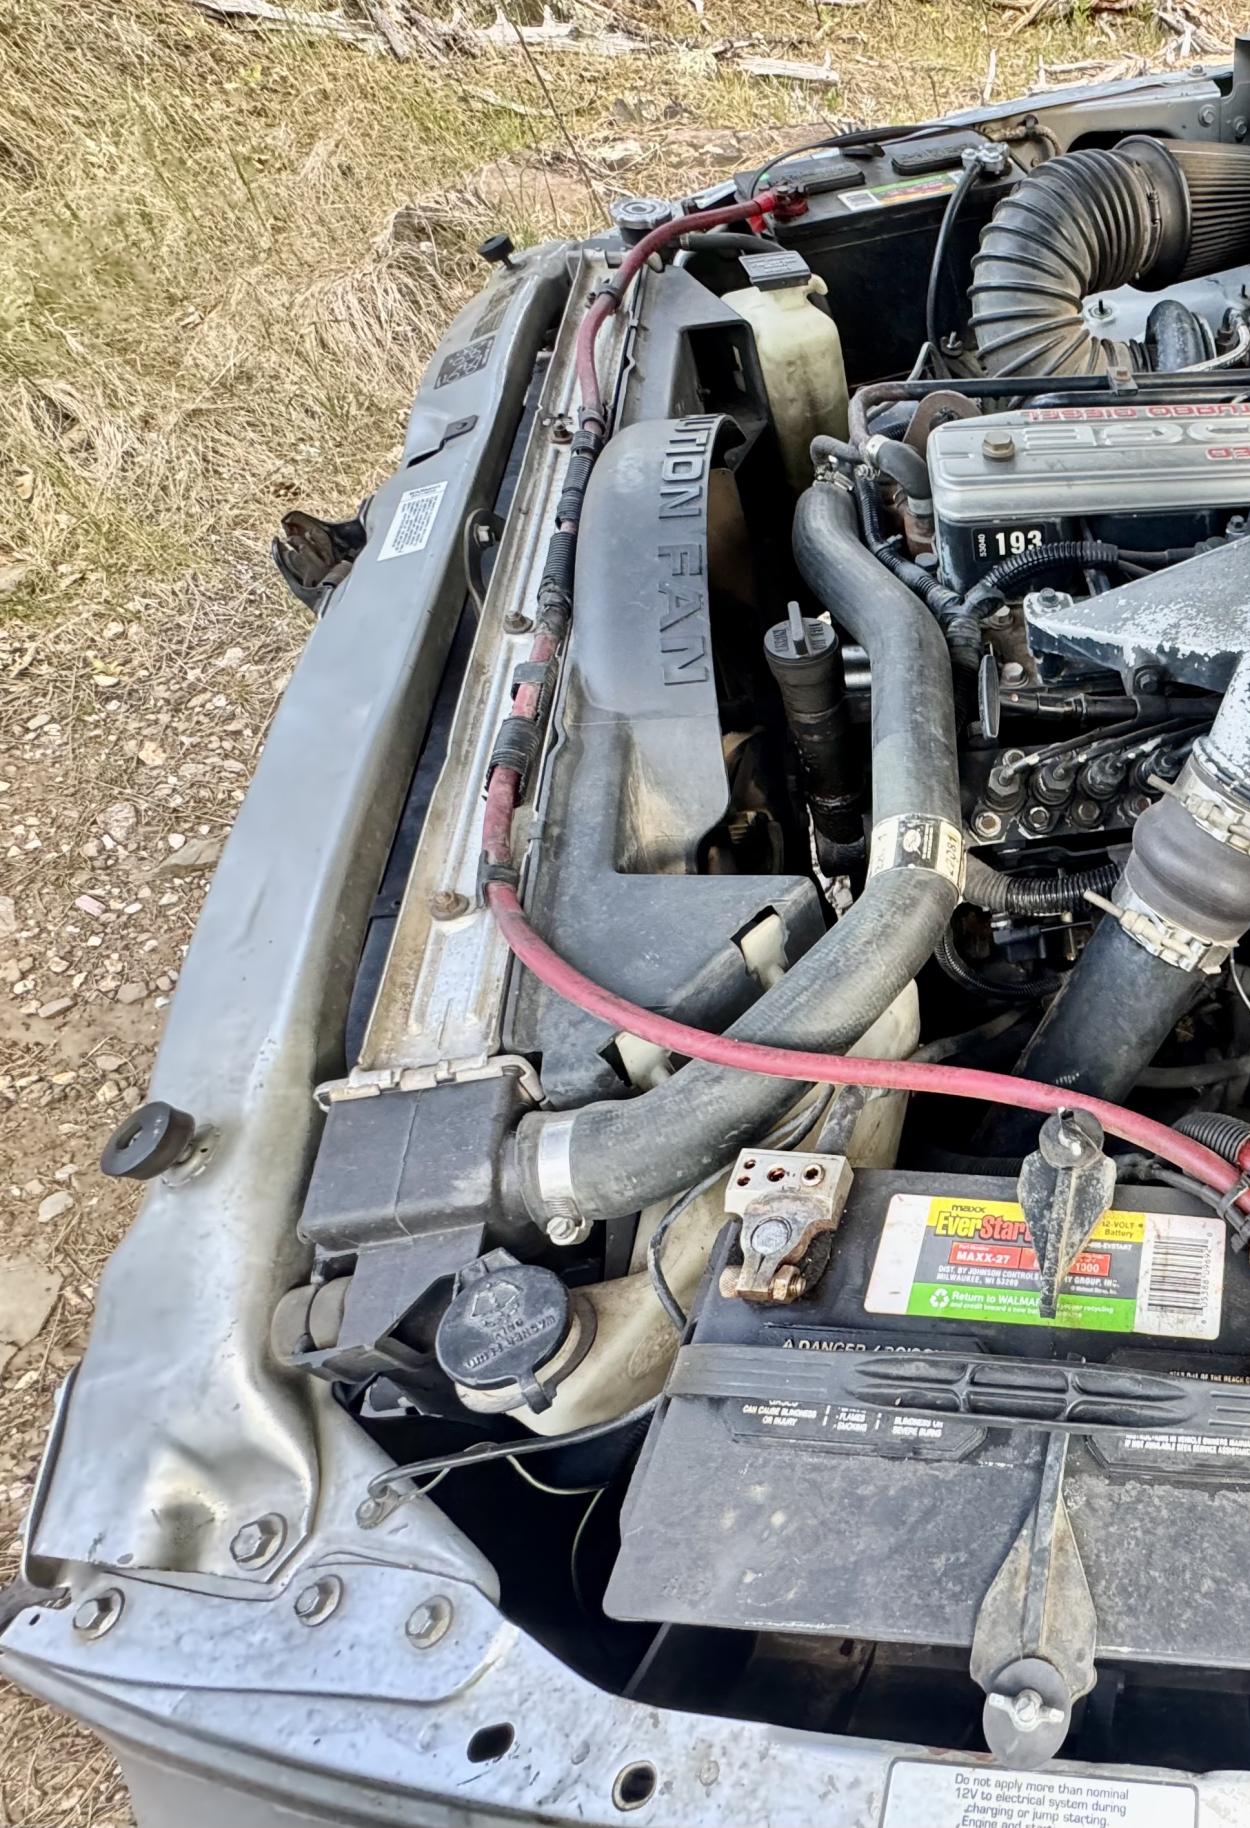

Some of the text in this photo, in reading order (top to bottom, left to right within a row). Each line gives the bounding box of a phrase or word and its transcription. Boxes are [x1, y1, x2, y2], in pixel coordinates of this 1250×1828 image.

[1023, 406, 1138, 423] DIESEL
[658, 413, 719, 686] UTION FAN
[995, 530, 1043, 556] 193
[951, 1204, 986, 1214] maxx
[1104, 1229, 1134, 1239] Battery
[956, 1252, 1010, 1264] MAXX-27
[957, 1267, 967, 1275] BY
[1075, 1262, 1099, 1273] 1000
[952, 1291, 1041, 1307] Return to WALMAR
[742, 1404, 758, 1414] CAN
[762, 1415, 772, 1425] OR
[954, 1773, 1129, 1800] Do not apply more than nominal
[954, 1787, 1128, 1817] 12V to electrical system during
[961, 1815, 998, 1828] Engine
[964, 1803, 1110, 1827] charging or jump starting.
